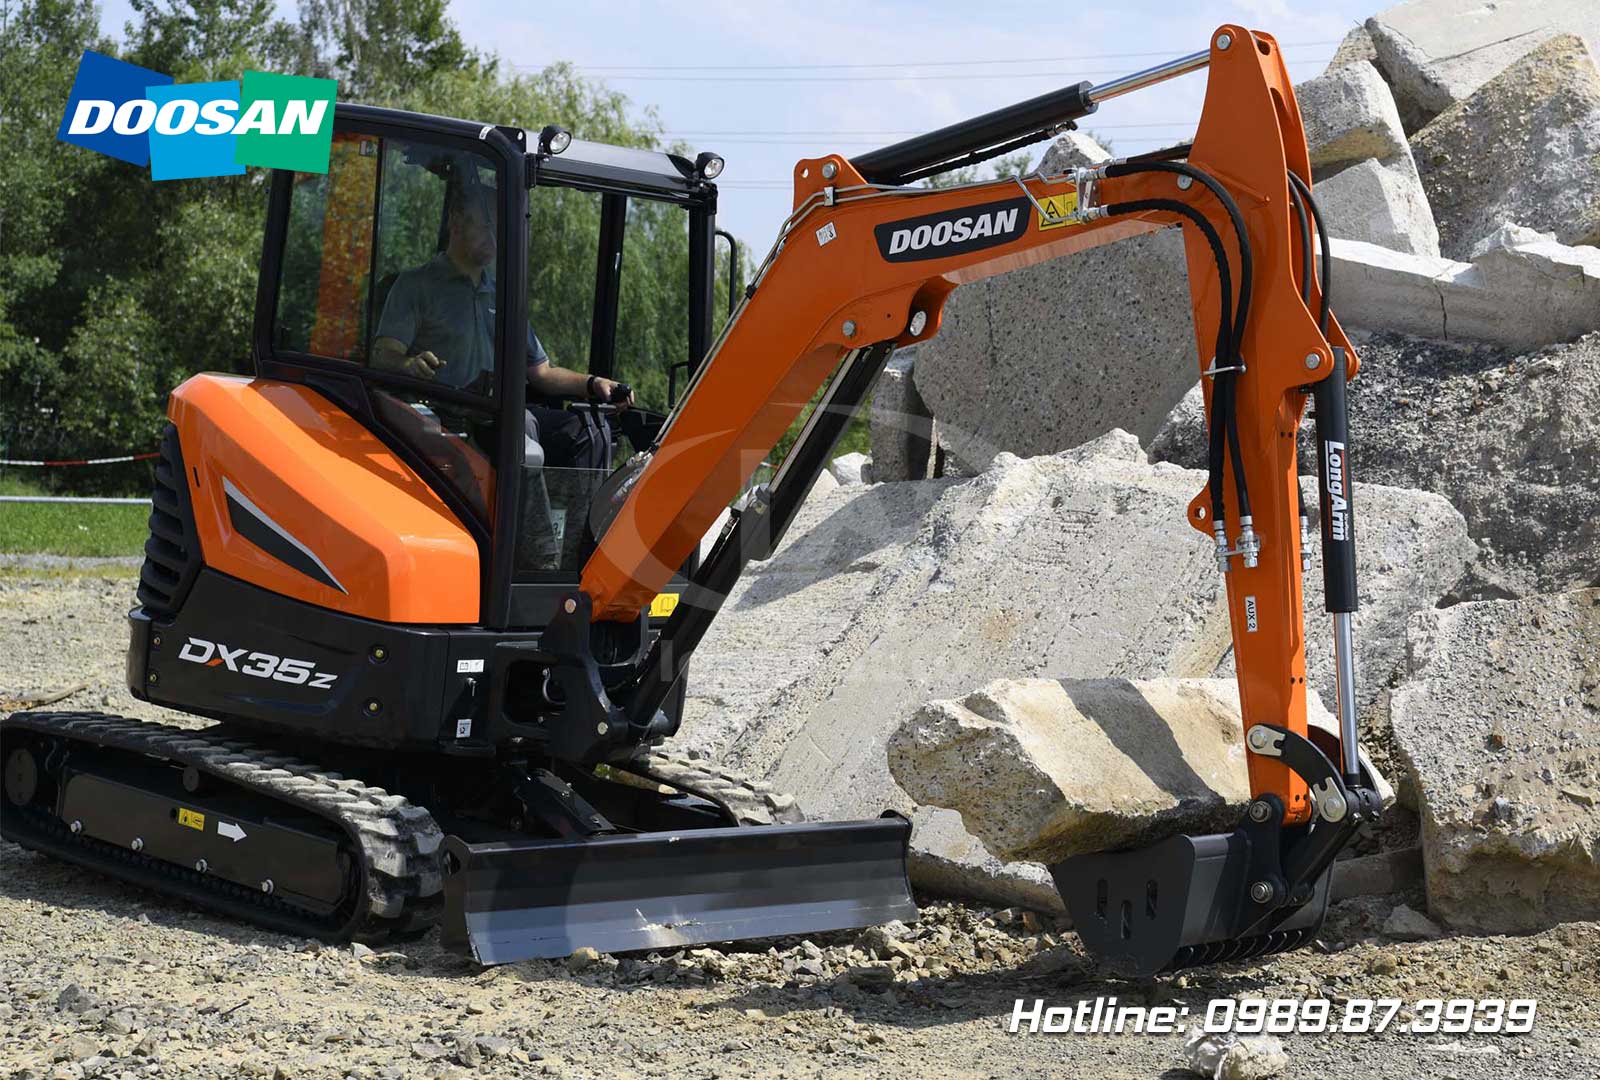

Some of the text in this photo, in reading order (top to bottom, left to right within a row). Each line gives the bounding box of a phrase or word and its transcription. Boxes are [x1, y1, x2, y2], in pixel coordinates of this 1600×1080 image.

[888, 208, 1019, 255] DOOSAN
[1325, 440, 1347, 541] LongArm
[1247, 599, 1256, 621] AUX
